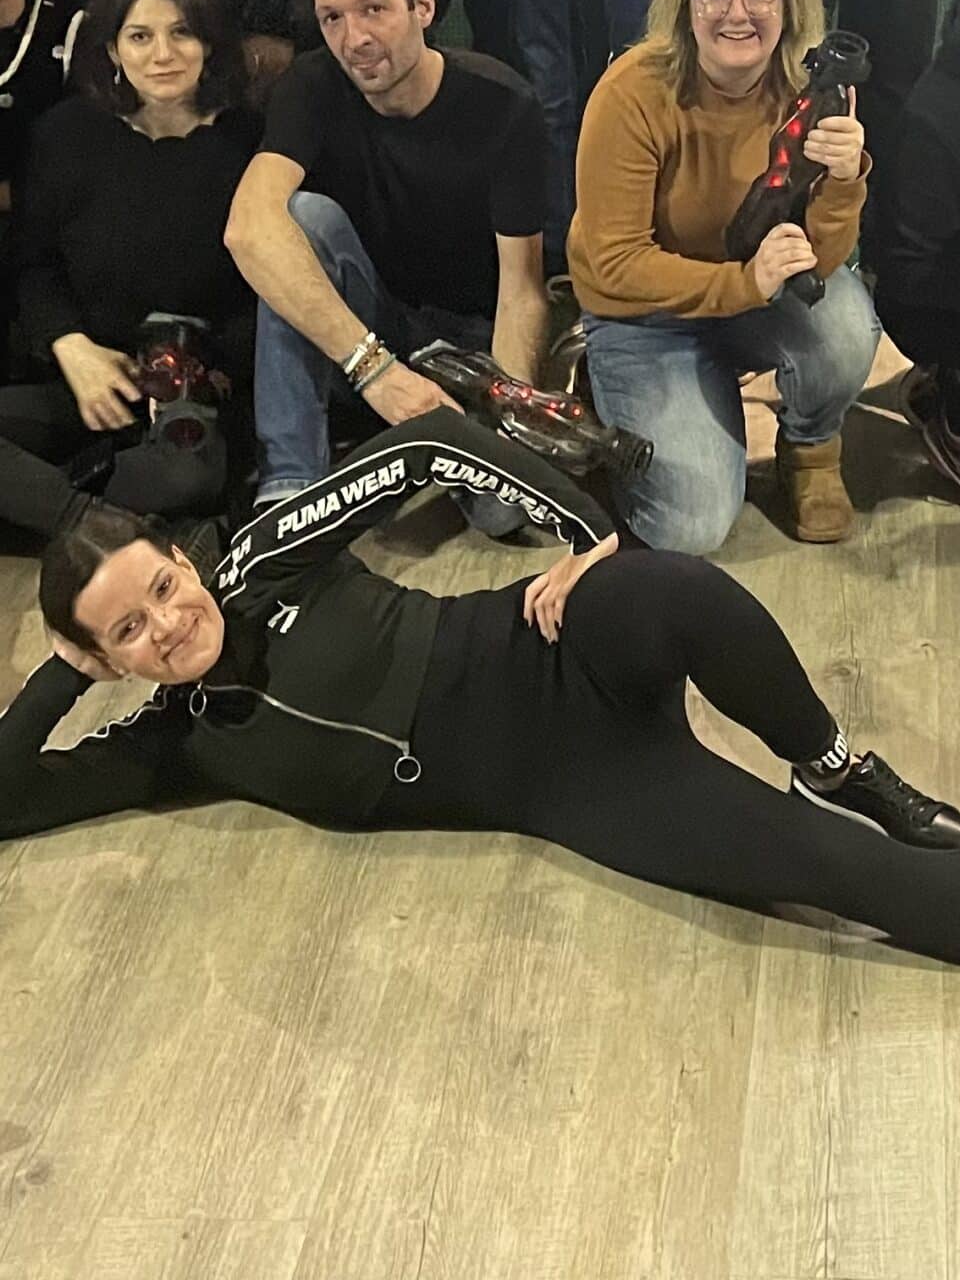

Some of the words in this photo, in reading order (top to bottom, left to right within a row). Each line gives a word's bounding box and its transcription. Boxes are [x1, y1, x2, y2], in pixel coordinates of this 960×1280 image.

[277, 491, 342, 540] PUMA
[340, 458, 405, 505] WEAR
[430, 456, 499, 490] PUMA
